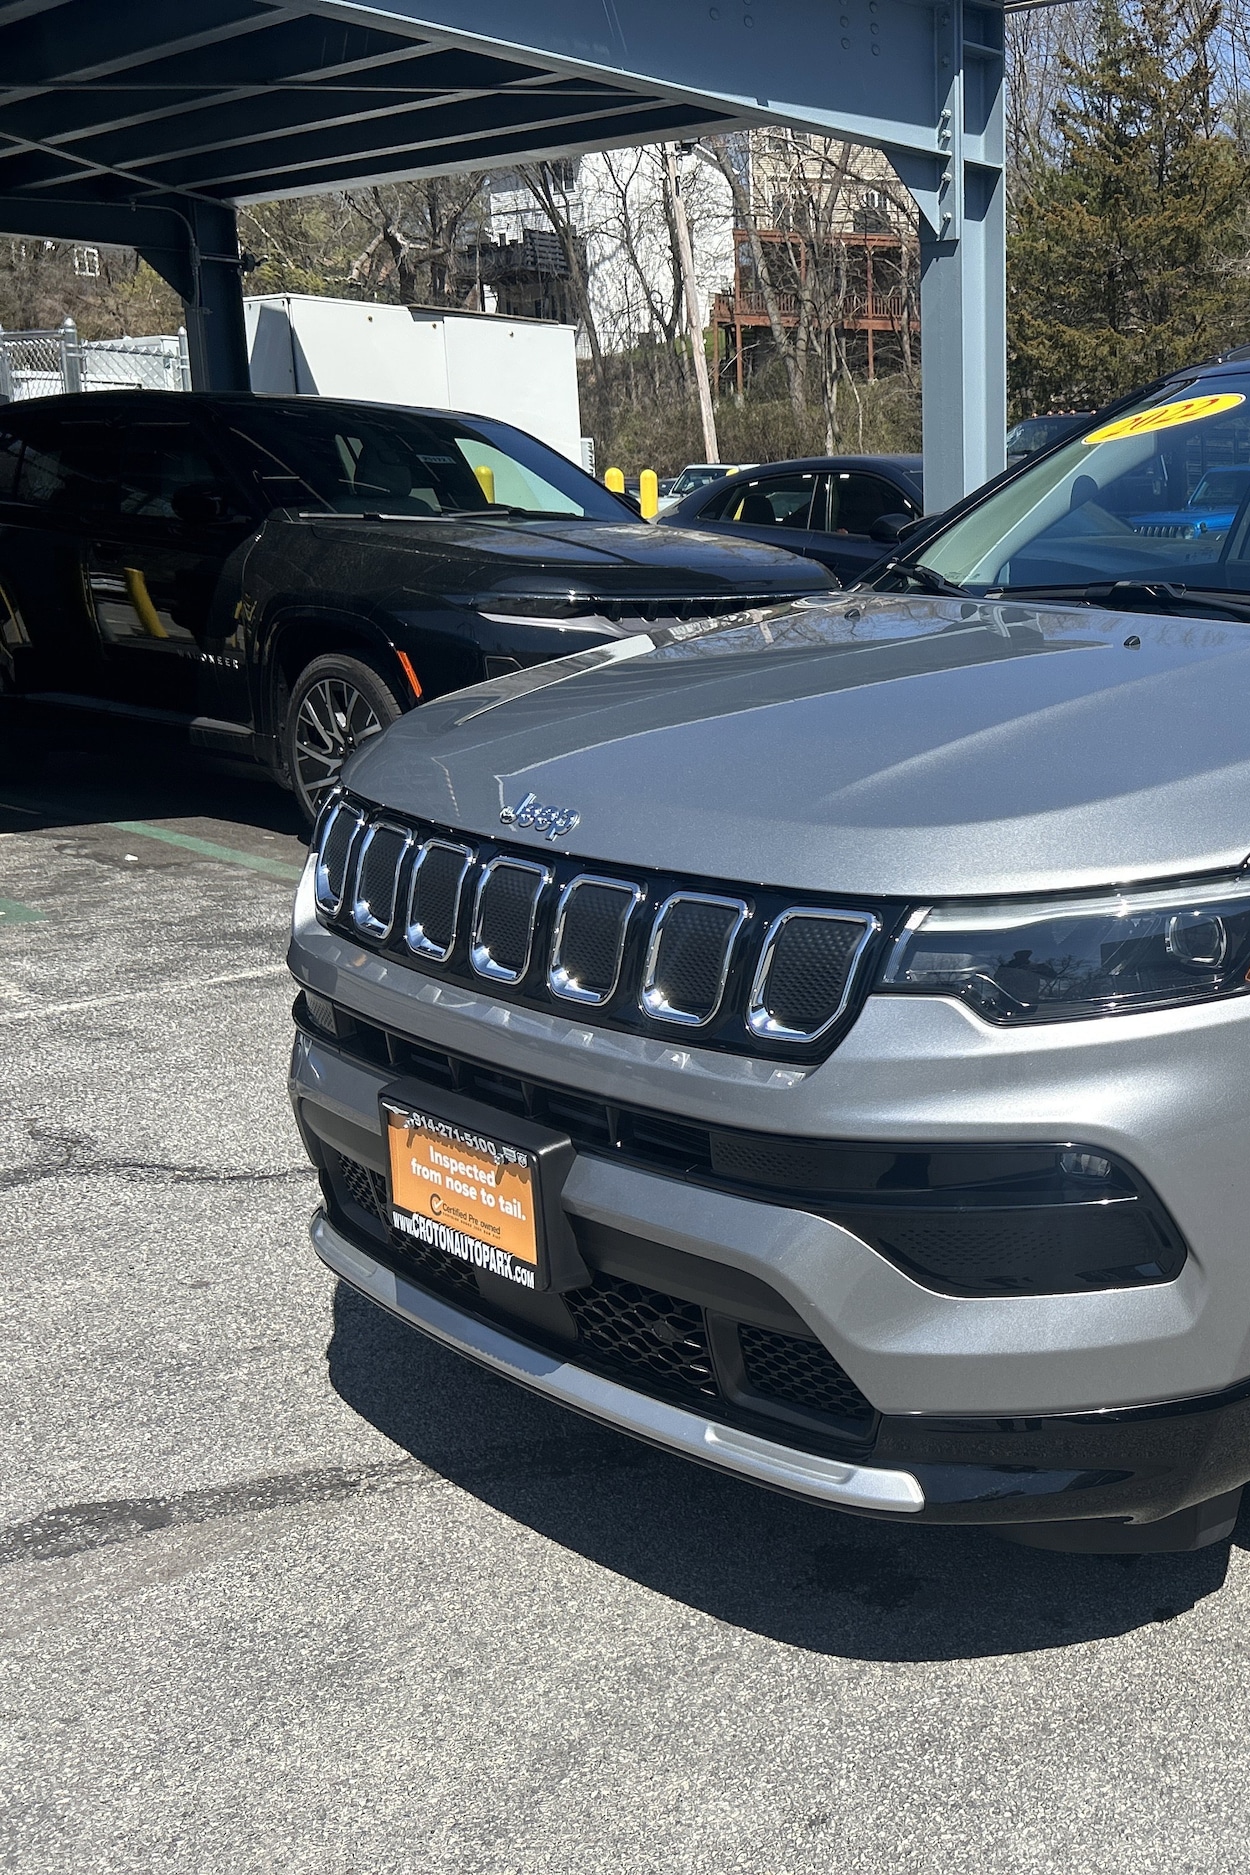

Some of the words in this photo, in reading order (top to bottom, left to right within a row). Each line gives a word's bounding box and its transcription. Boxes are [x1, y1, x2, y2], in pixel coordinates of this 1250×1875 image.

[1101, 398, 1220, 439] 2022
[500, 792, 580, 841] Jeep
[429, 1145, 497, 1188] Inspected
[410, 1158, 443, 1186] from
[445, 1177, 478, 1201] nose
[480, 1188, 496, 1208] to
[498, 1196, 527, 1221] tail.
[442, 1203, 467, 1220] Certified
[468, 1213, 479, 1225] Pre
[480, 1220, 501, 1235] owned
